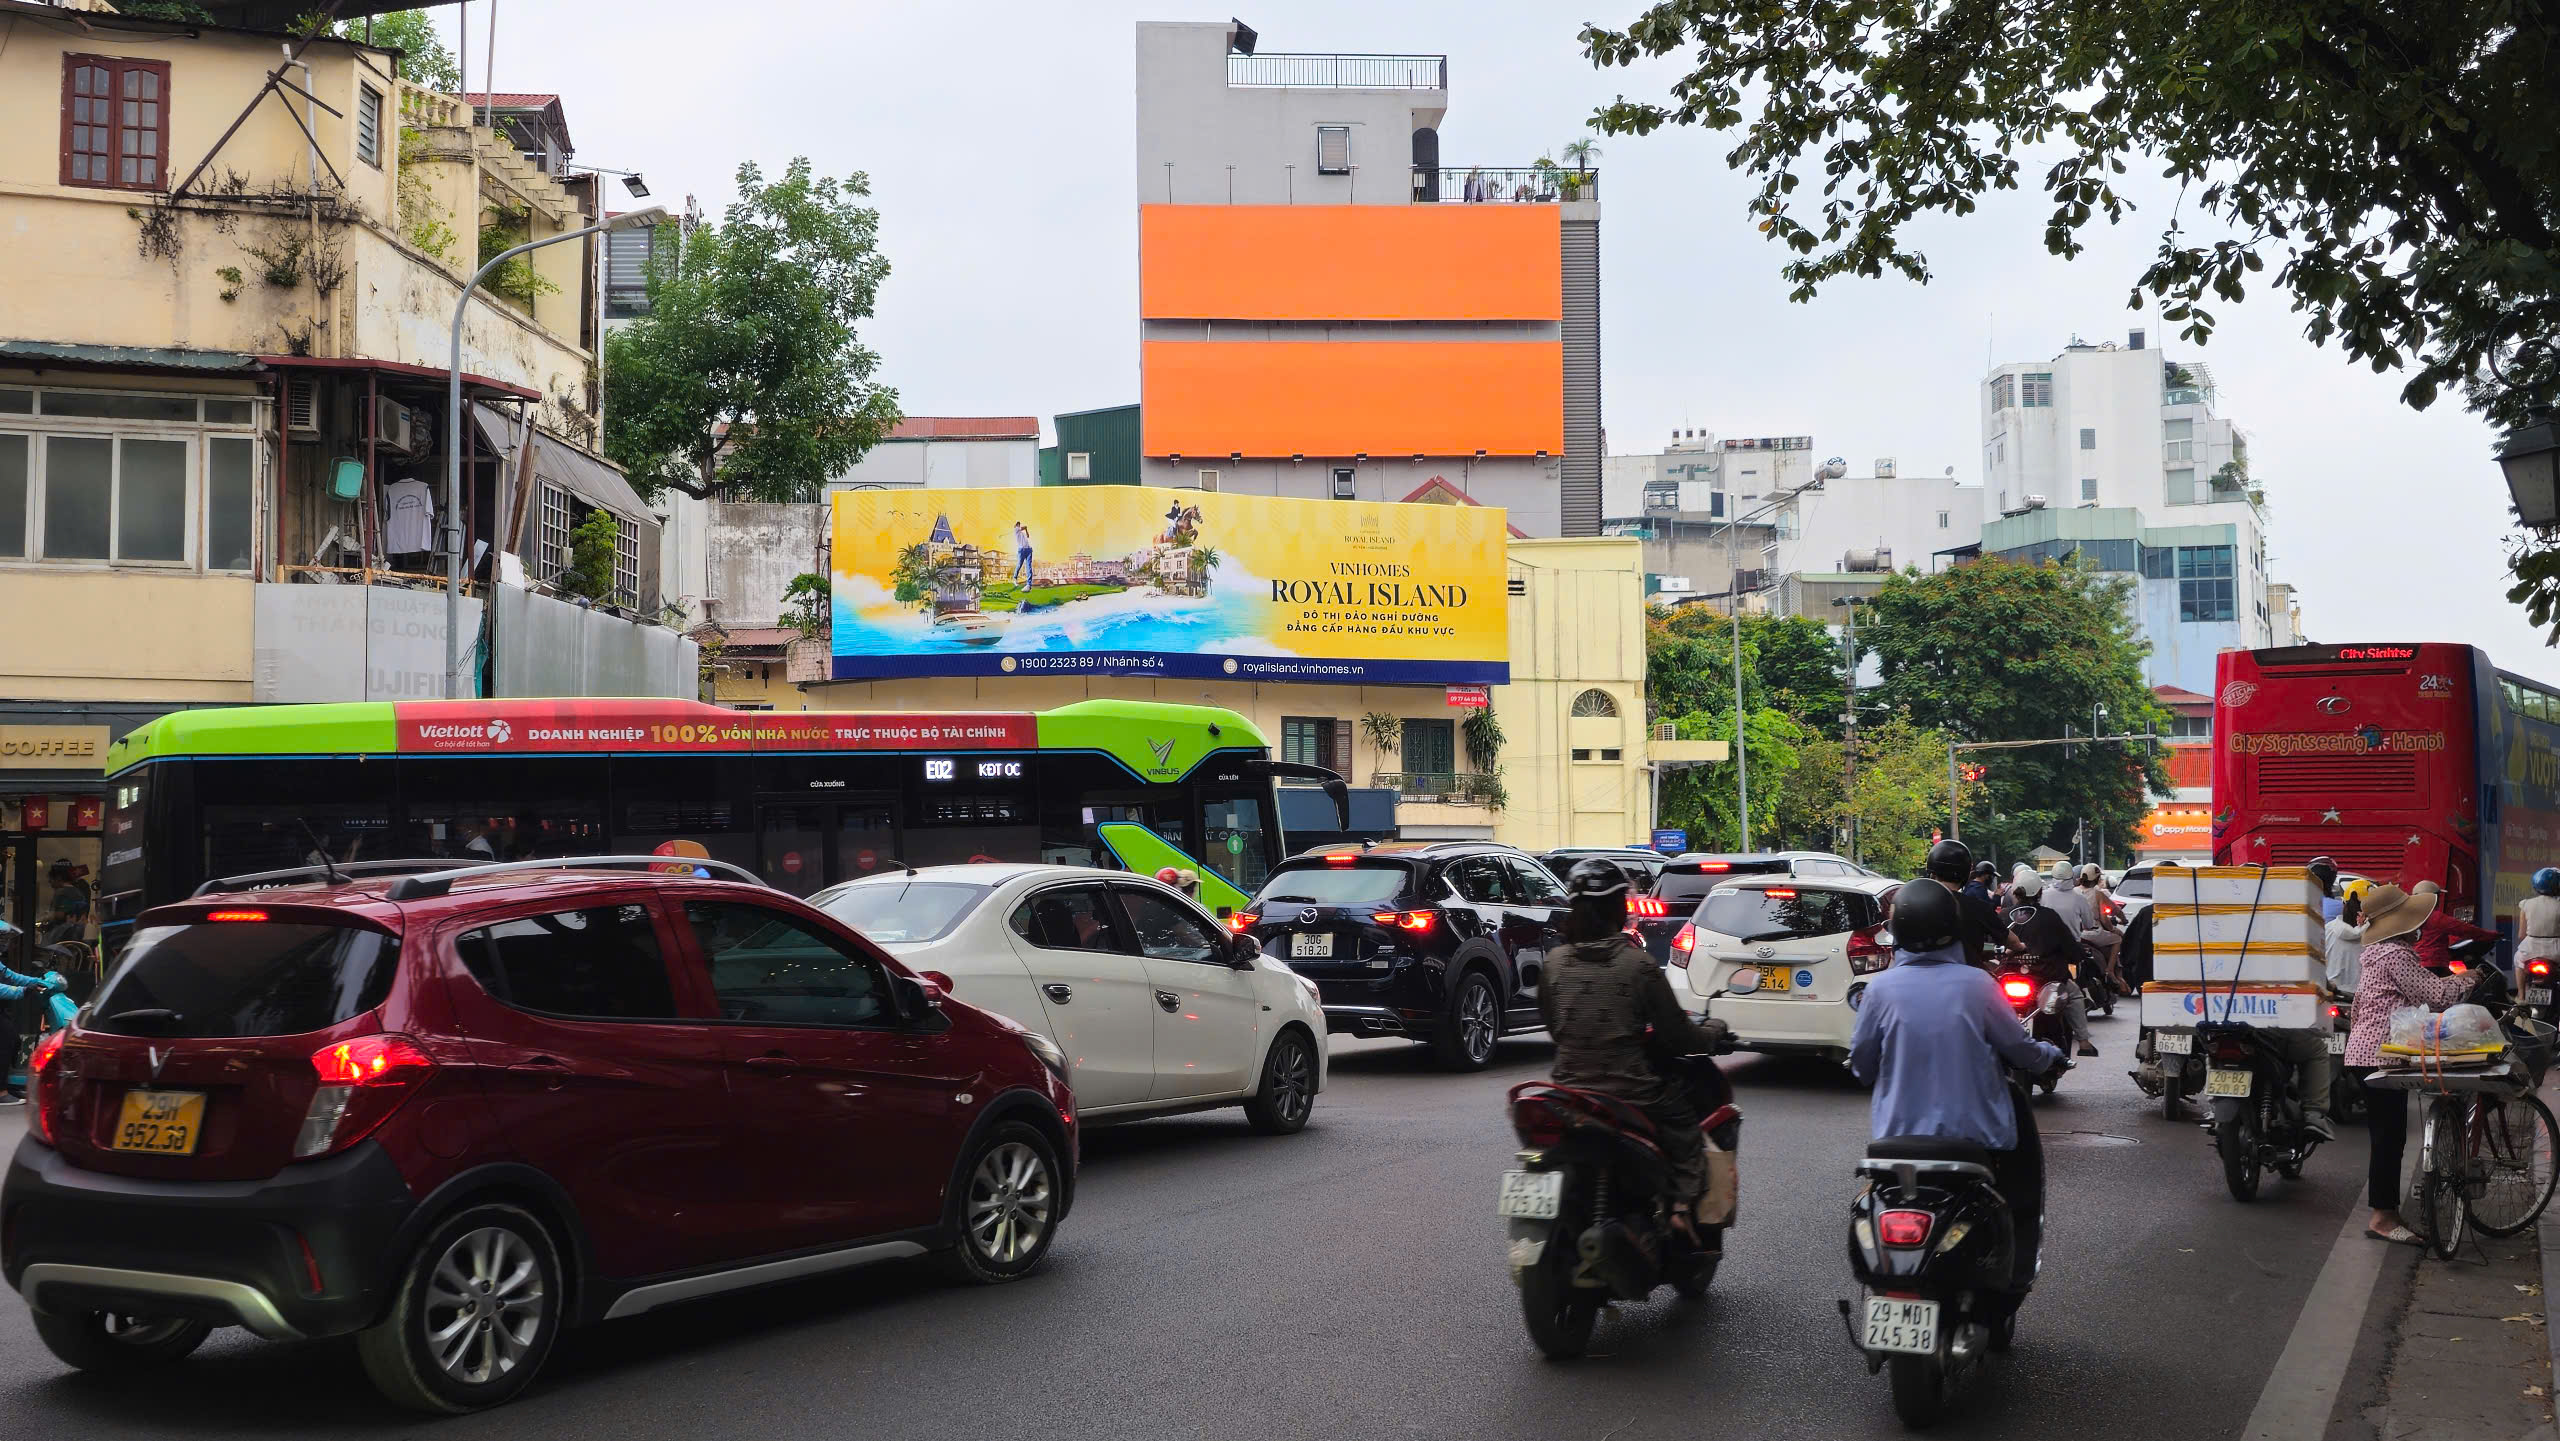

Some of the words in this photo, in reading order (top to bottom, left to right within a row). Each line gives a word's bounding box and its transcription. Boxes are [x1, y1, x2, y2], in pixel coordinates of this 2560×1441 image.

[1344, 535, 1367, 544] ROYAL
[1369, 535, 1395, 545] ISLAND
[1330, 562, 1410, 578] VINHOMES
[1272, 579, 1362, 605] ROYAL
[1368, 583, 1467, 608] ISLAND
[1303, 610, 1318, 619] ĐÔ
[1323, 612, 1340, 621] THỊ
[1345, 610, 1367, 621] ĐẢO
[1372, 610, 1398, 622] NGHỈ
[1402, 612, 1439, 622] DƯỠNG
[1287, 620, 1317, 632] ĐẲNG
[1322, 622, 1343, 633] CẤP
[1347, 623, 1377, 634] HÀNG
[1408, 626, 1429, 635] KHU
[1433, 627, 1455, 637] VỰC
[1020, 657, 1047, 669] 1900
[1049, 656, 1077, 669] 2323
[1079, 656, 1094, 668] 89
[1103, 655, 1140, 668] Nhánh
[1142, 655, 1156, 668] số
[1157, 657, 1164, 668] 4
[1243, 661, 1364, 676] royalisland.vinhomes.vn
[2420, 674, 2438, 690] 24
[419, 724, 484, 738] Vietlott
[528, 729, 584, 740] DOANH
[588, 726, 645, 742] NGHIỆP
[650, 724, 718, 743] 100%
[721, 723, 752, 740] VỐN
[756, 726, 787, 740] NHÀ
[791, 726, 829, 740] NƯỚC
[835, 727, 870, 742] TRỰC
[873, 725, 918, 742] THUỘC
[921, 726, 940, 742] BỘ
[943, 725, 964, 739] TÀI
[966, 724, 1006, 739] CHÍNH
[0, 737, 95, 756] COFFEE
[444, 740, 456, 749] hội
[457, 739, 466, 748] để
[466, 739, 476, 748] tốt
[2392, 731, 2445, 752] Hanoi
[926, 760, 954, 780] E02
[1004, 763, 1021, 777] OC
[1147, 767, 1180, 776] VINBUS
[1304, 934, 1322, 945] 30G
[1296, 945, 1328, 956] 518.20
[2158, 1042, 2190, 1053] 062.14
[2214, 1072, 2245, 1084] 20-B2
[2208, 1083, 2248, 1096] 520.83
[1868, 1324, 1932, 1350] 245.38
